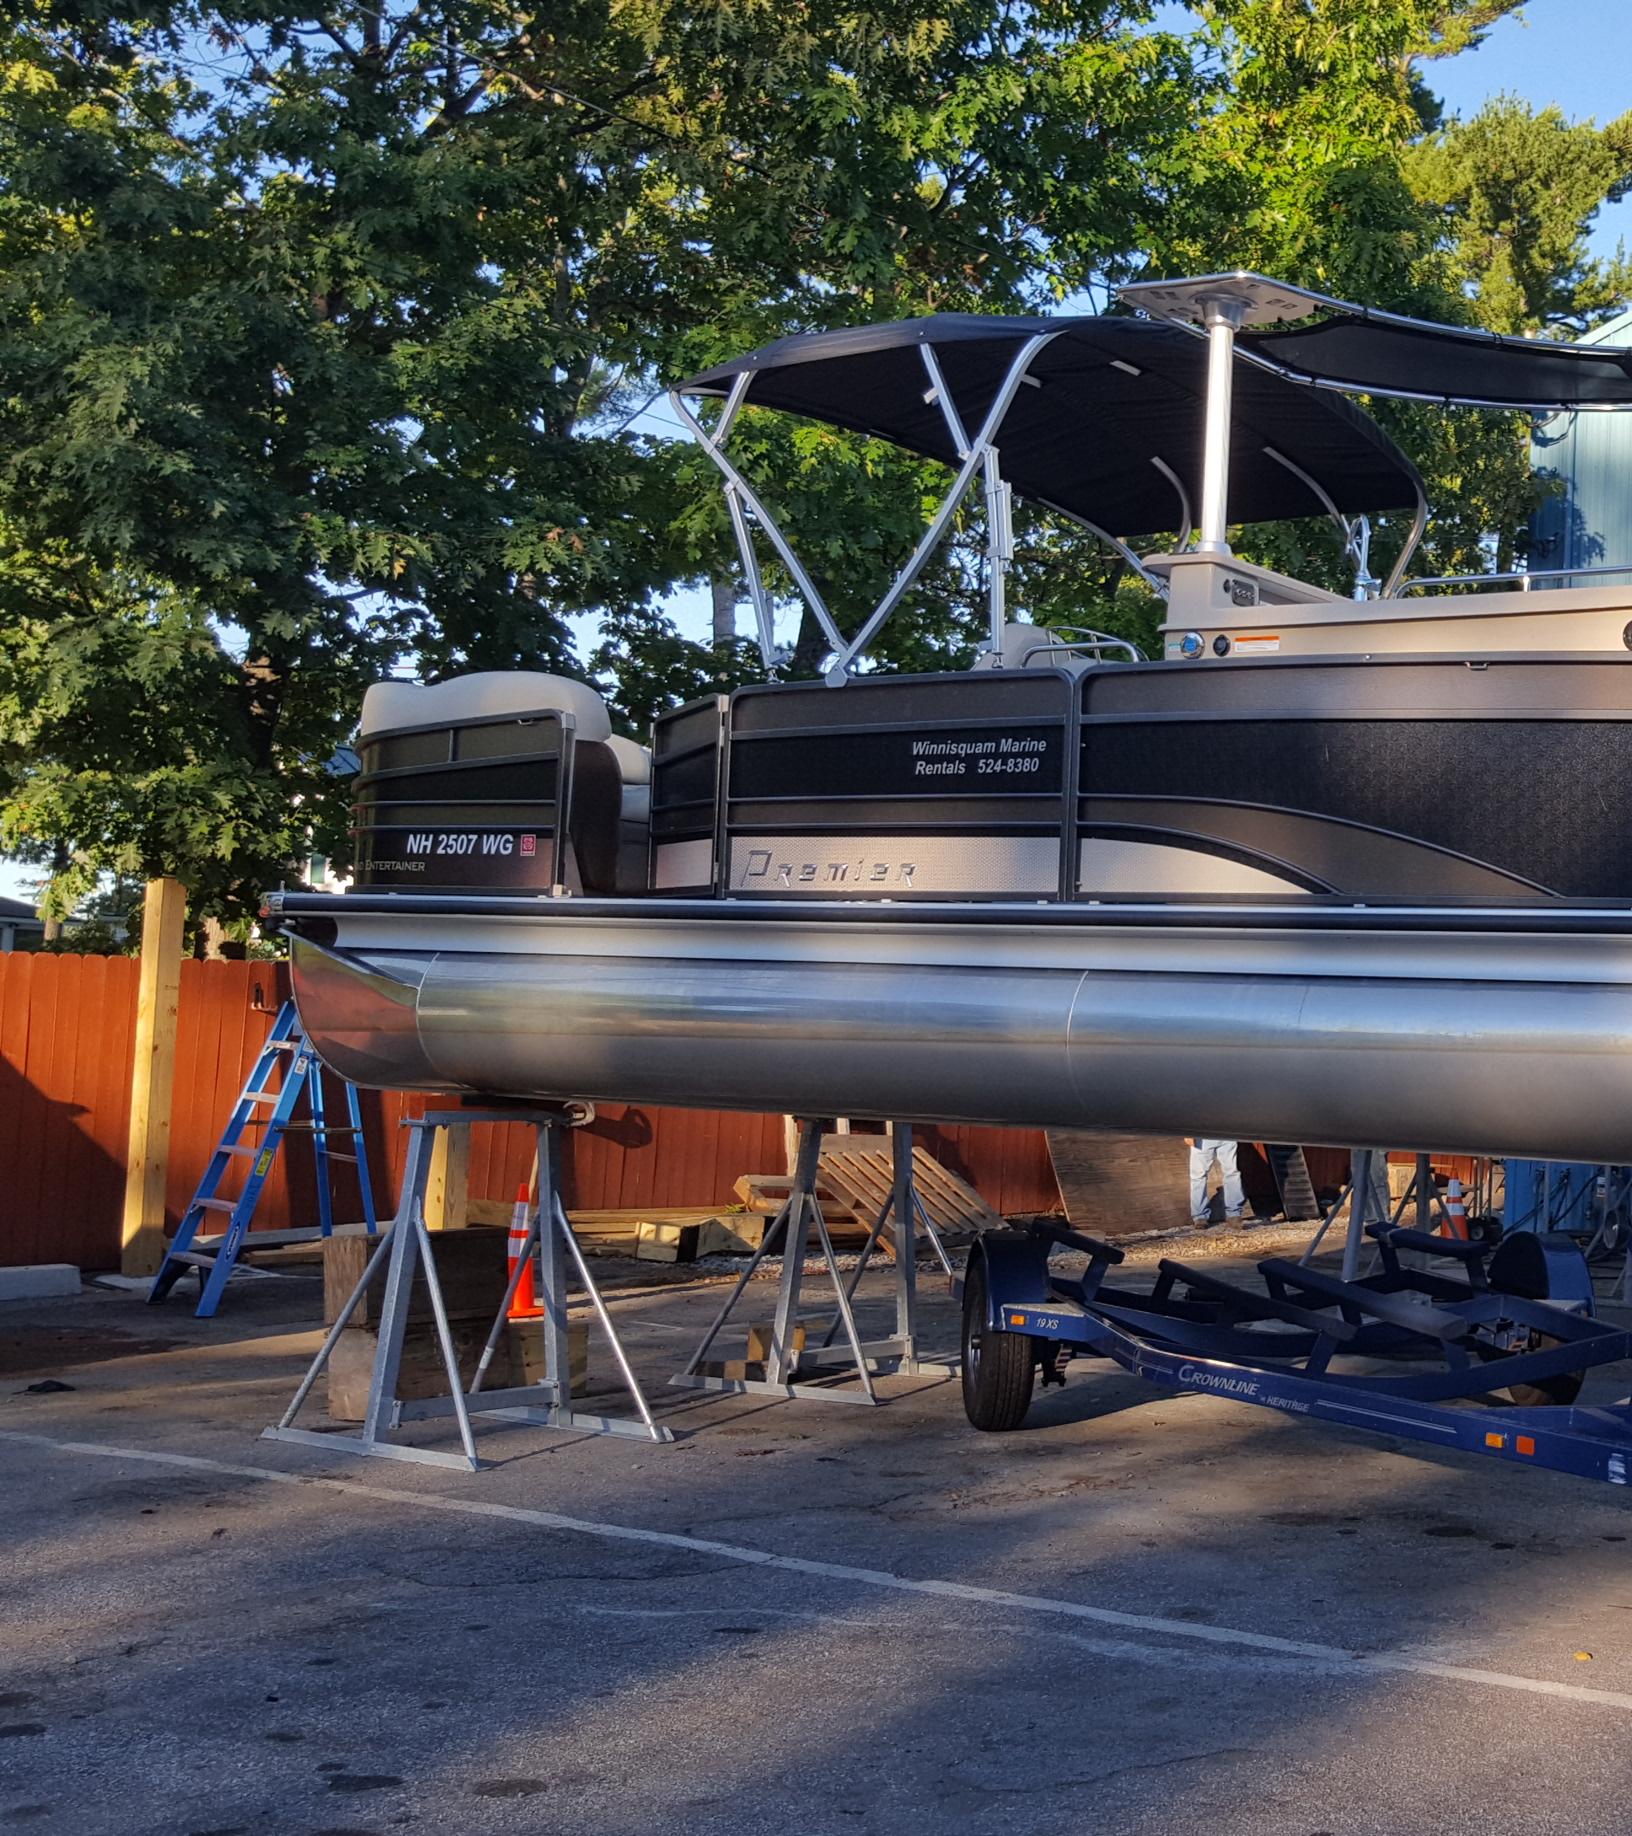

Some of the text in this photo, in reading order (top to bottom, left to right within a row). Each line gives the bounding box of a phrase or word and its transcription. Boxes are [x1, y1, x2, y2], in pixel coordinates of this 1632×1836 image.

[912, 737, 1047, 757] Winnisquam Marine
[915, 757, 1040, 775] Rentals 524-8380
[406, 833, 433, 854] NH
[436, 834, 478, 855] 2507
[482, 834, 515, 856] WG
[365, 859, 426, 872] ENTERTAINER
[1036, 1317, 1059, 1330] 19 XS
[1178, 1364, 1260, 1396] CROWNLINE
